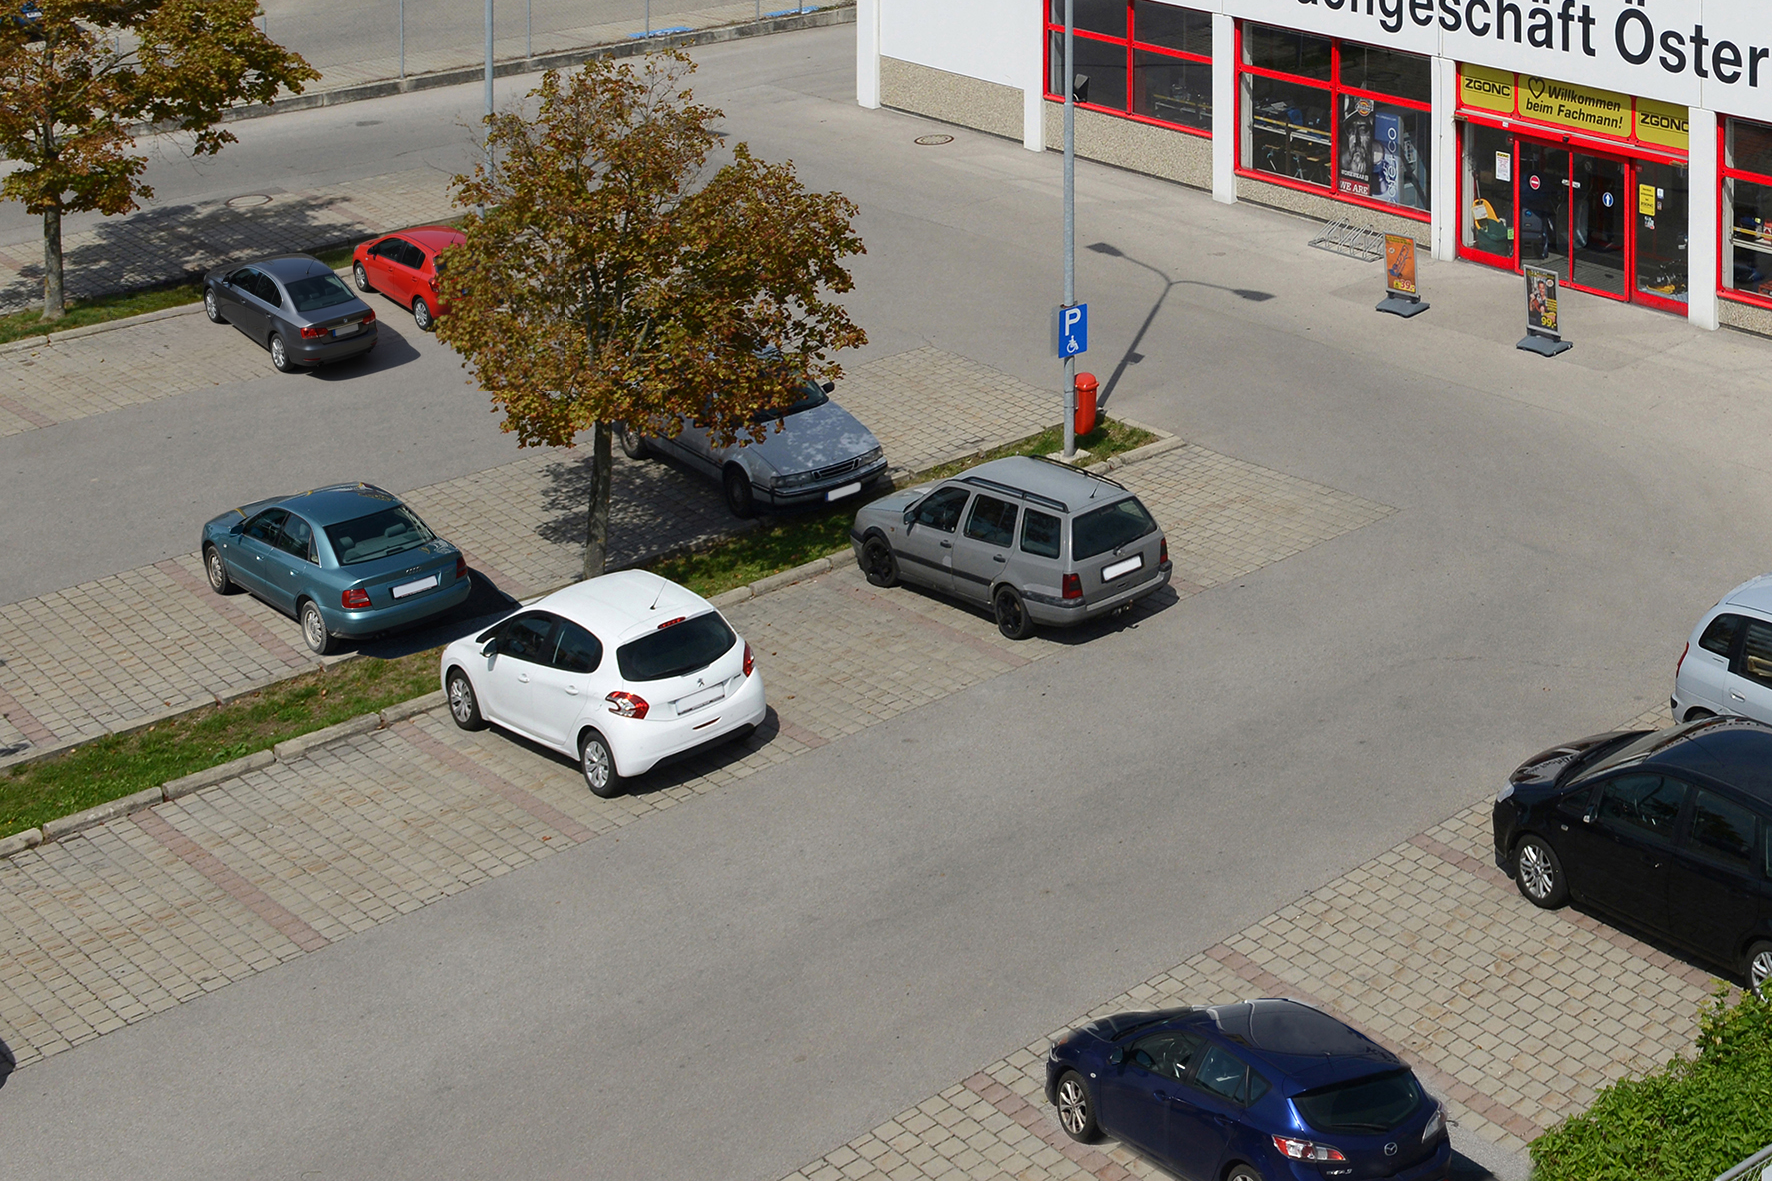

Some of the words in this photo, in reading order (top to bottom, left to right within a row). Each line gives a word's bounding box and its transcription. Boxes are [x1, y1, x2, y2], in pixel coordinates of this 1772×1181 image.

[1464, 77, 1511, 97] ZGONC
[1548, 85, 1622, 112] Willkommen
[1525, 98, 1553, 115] beim
[1557, 104, 1624, 130] Fachmann!
[1639, 112, 1689, 133] ZGONC
[1340, 180, 1352, 191] WE
[1352, 183, 1369, 195] ARE
[1064, 307, 1082, 337] P
